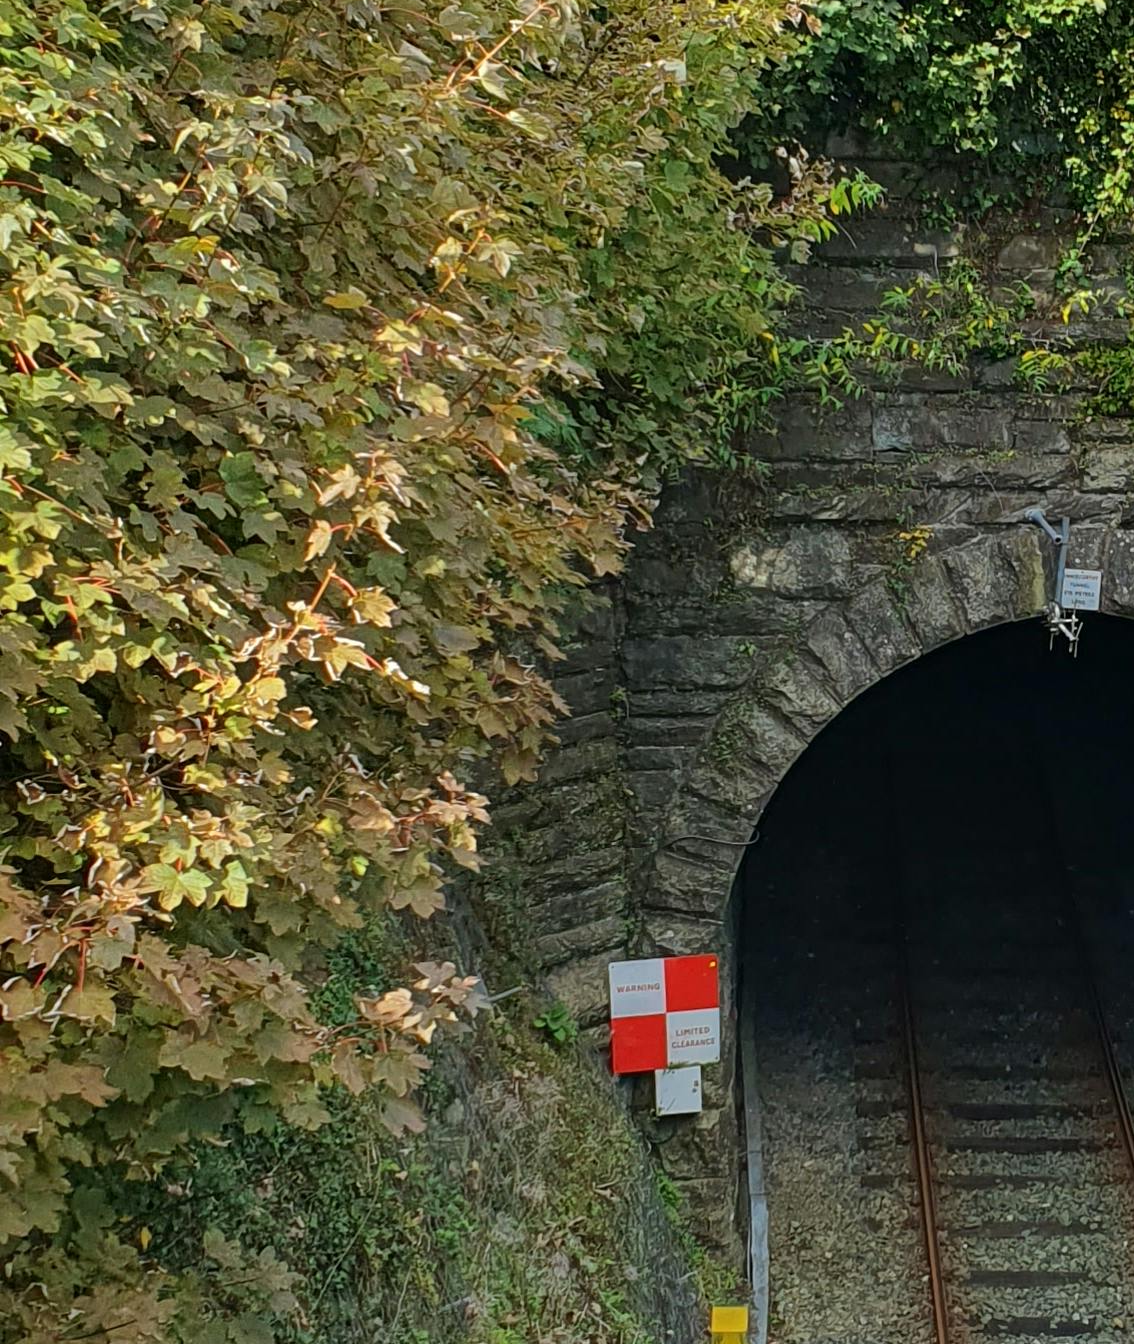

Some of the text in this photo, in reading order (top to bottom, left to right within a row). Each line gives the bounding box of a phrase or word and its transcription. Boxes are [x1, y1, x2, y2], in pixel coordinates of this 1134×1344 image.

[616, 983, 660, 993] WARNING
[675, 1026, 711, 1037] LIMITED
[671, 1037, 716, 1049] CLEARANCE
